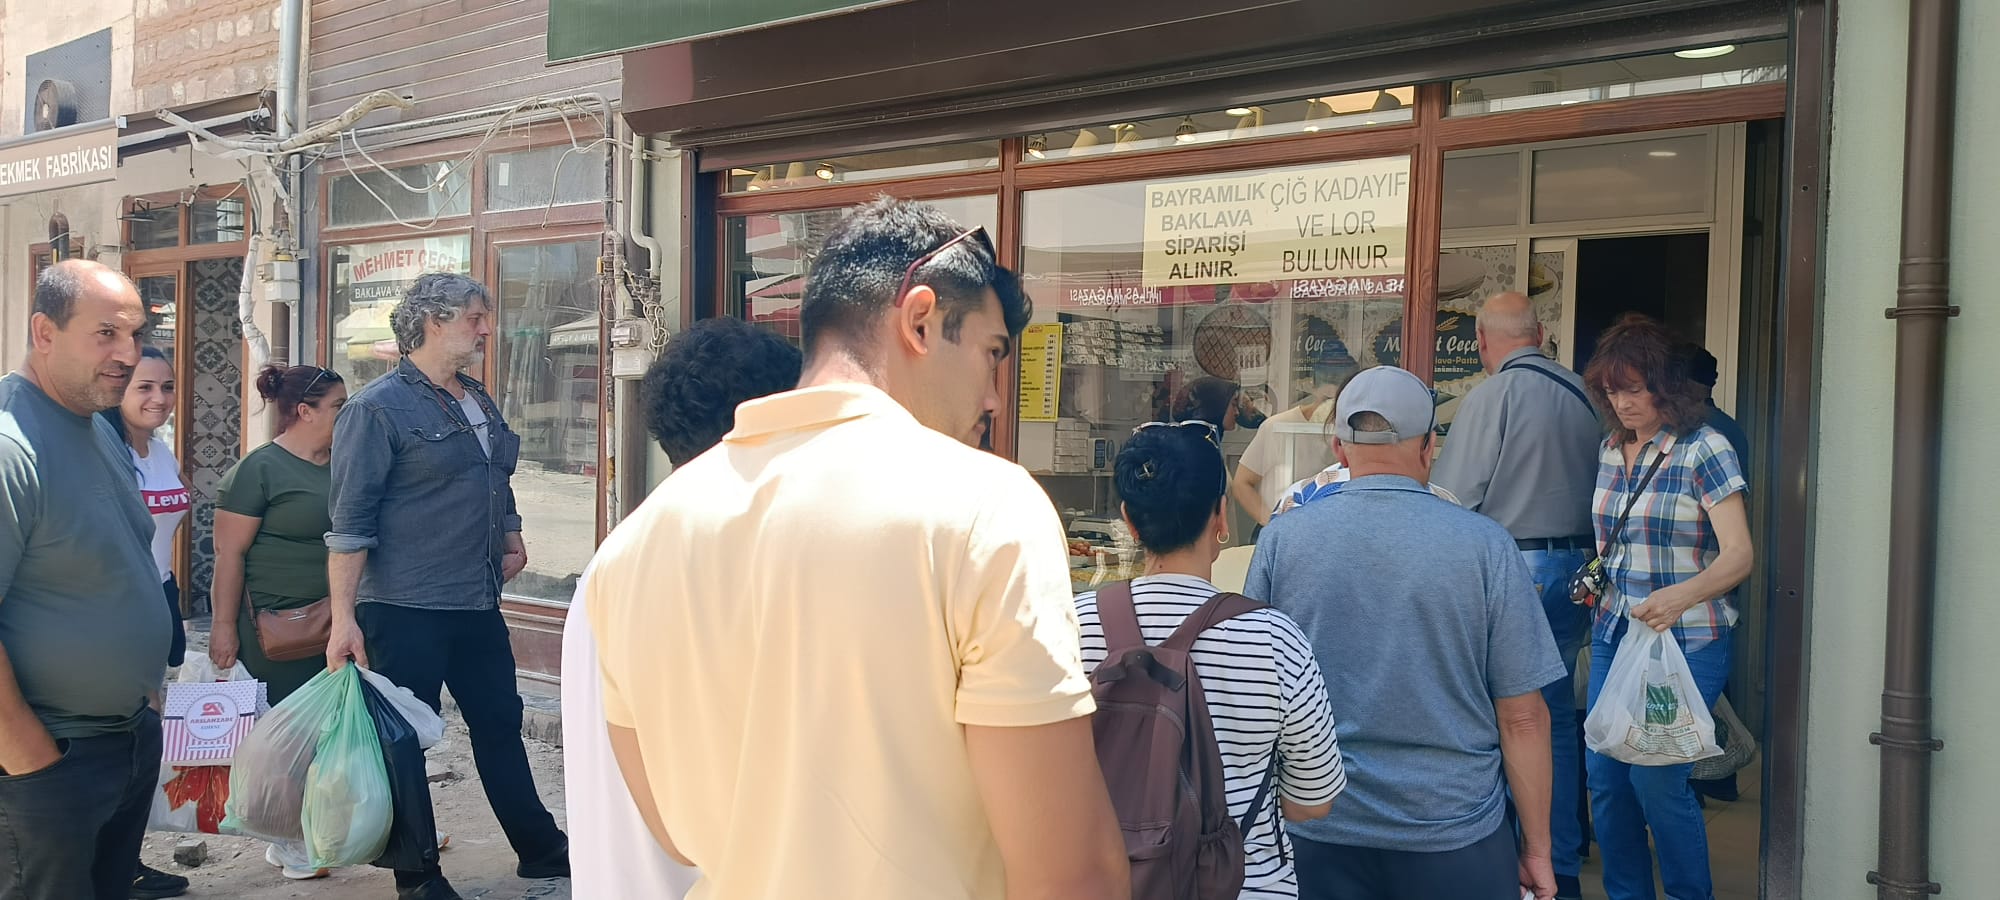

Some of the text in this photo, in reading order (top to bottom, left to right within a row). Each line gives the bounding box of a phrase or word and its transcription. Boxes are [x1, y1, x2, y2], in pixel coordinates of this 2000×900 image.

[0, 145, 112, 186] EKMEK FABRİKASI
[1151, 182, 1265, 208] BAYRAMLIK
[1270, 171, 1408, 212] ÇİĞ KADAYIF
[1162, 209, 1253, 232] BAKLAVA
[1296, 210, 1376, 238] VE LOR
[1165, 230, 1246, 256] SİPARİŞİ
[353, 249, 414, 281] MEHMET
[1169, 260, 1238, 280] ALINIR.
[1282, 244, 1388, 273] BULUNUR
[354, 286, 392, 299] BAKLAVA
[1446, 336, 1479, 354] Çeçe
